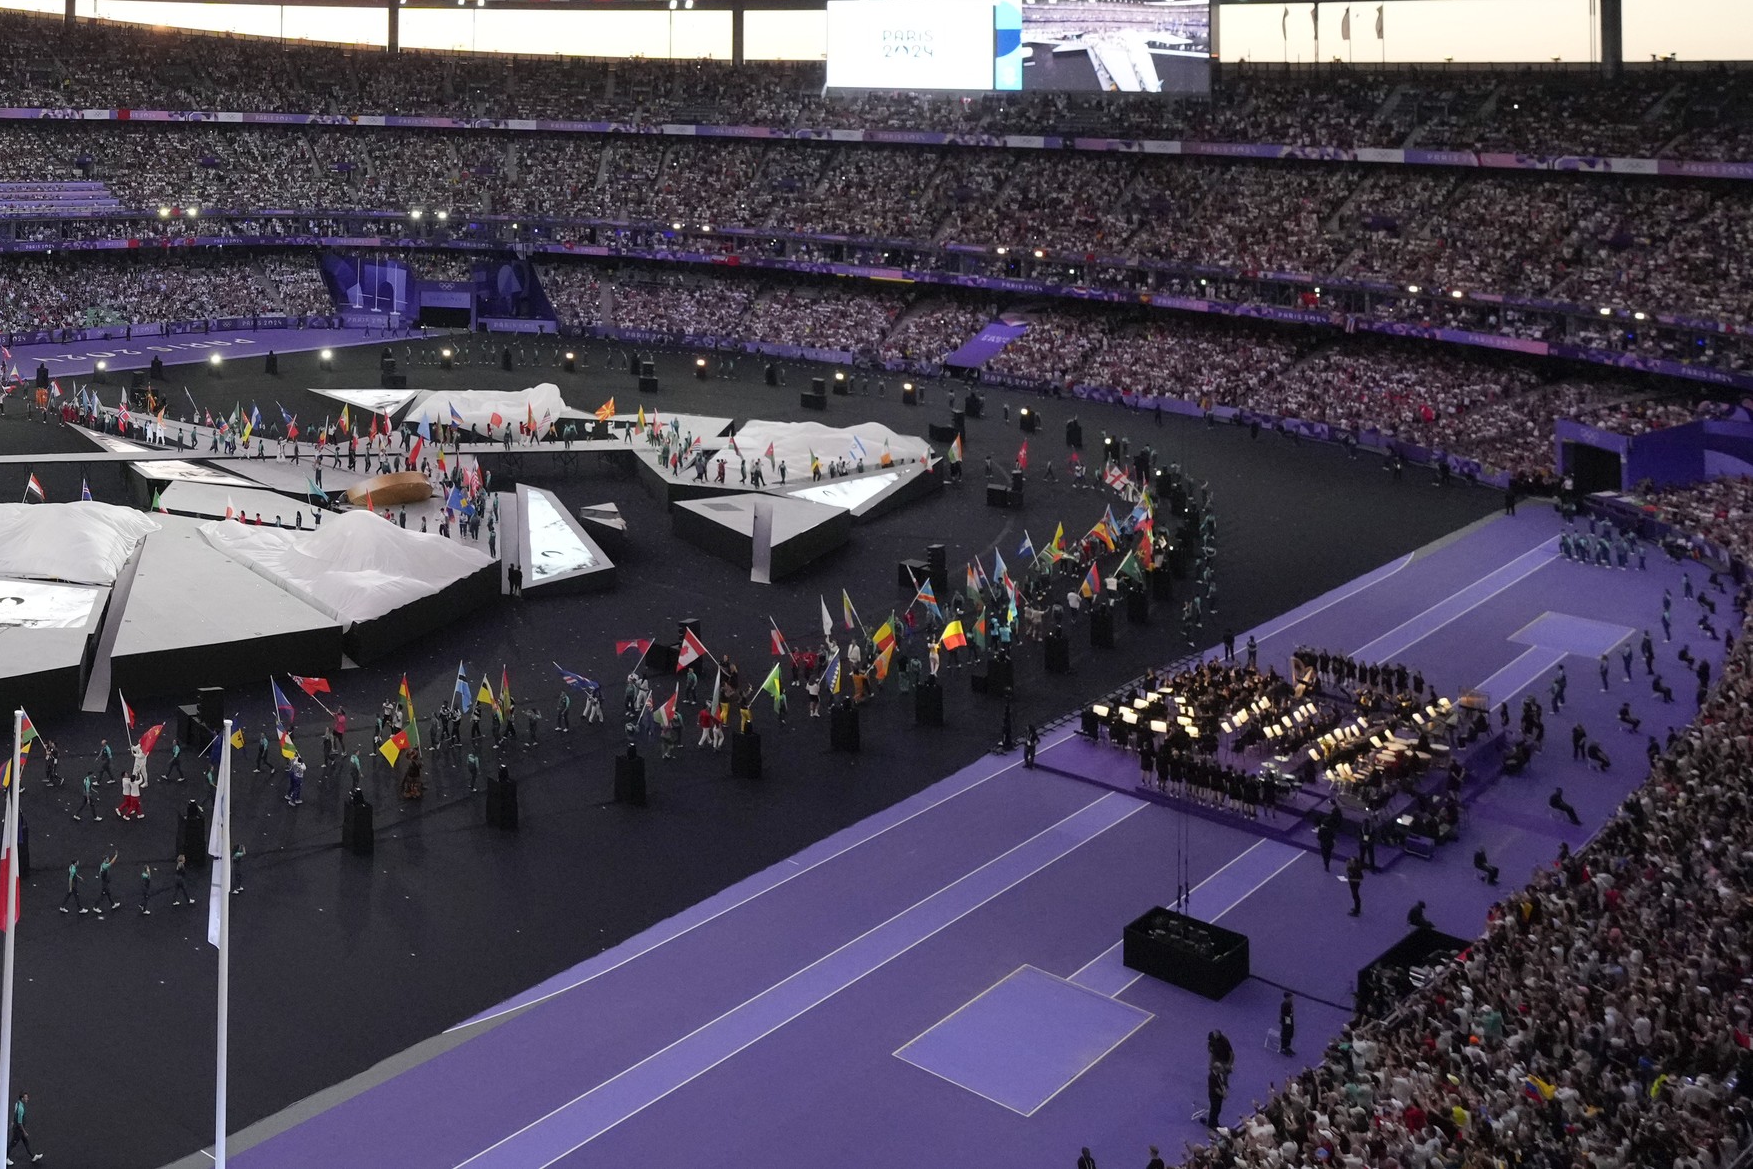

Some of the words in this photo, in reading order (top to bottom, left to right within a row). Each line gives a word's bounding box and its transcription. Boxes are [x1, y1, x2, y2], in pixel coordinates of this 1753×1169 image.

[882, 29, 934, 41] PARIS
[882, 45, 933, 57] 2024
[1278, 312, 1302, 320] PARIS
[625, 331, 649, 340] PARIS
[146, 337, 255, 352] PARIS
[32, 349, 142, 363] 2024
[985, 374, 1011, 384] PARIS
